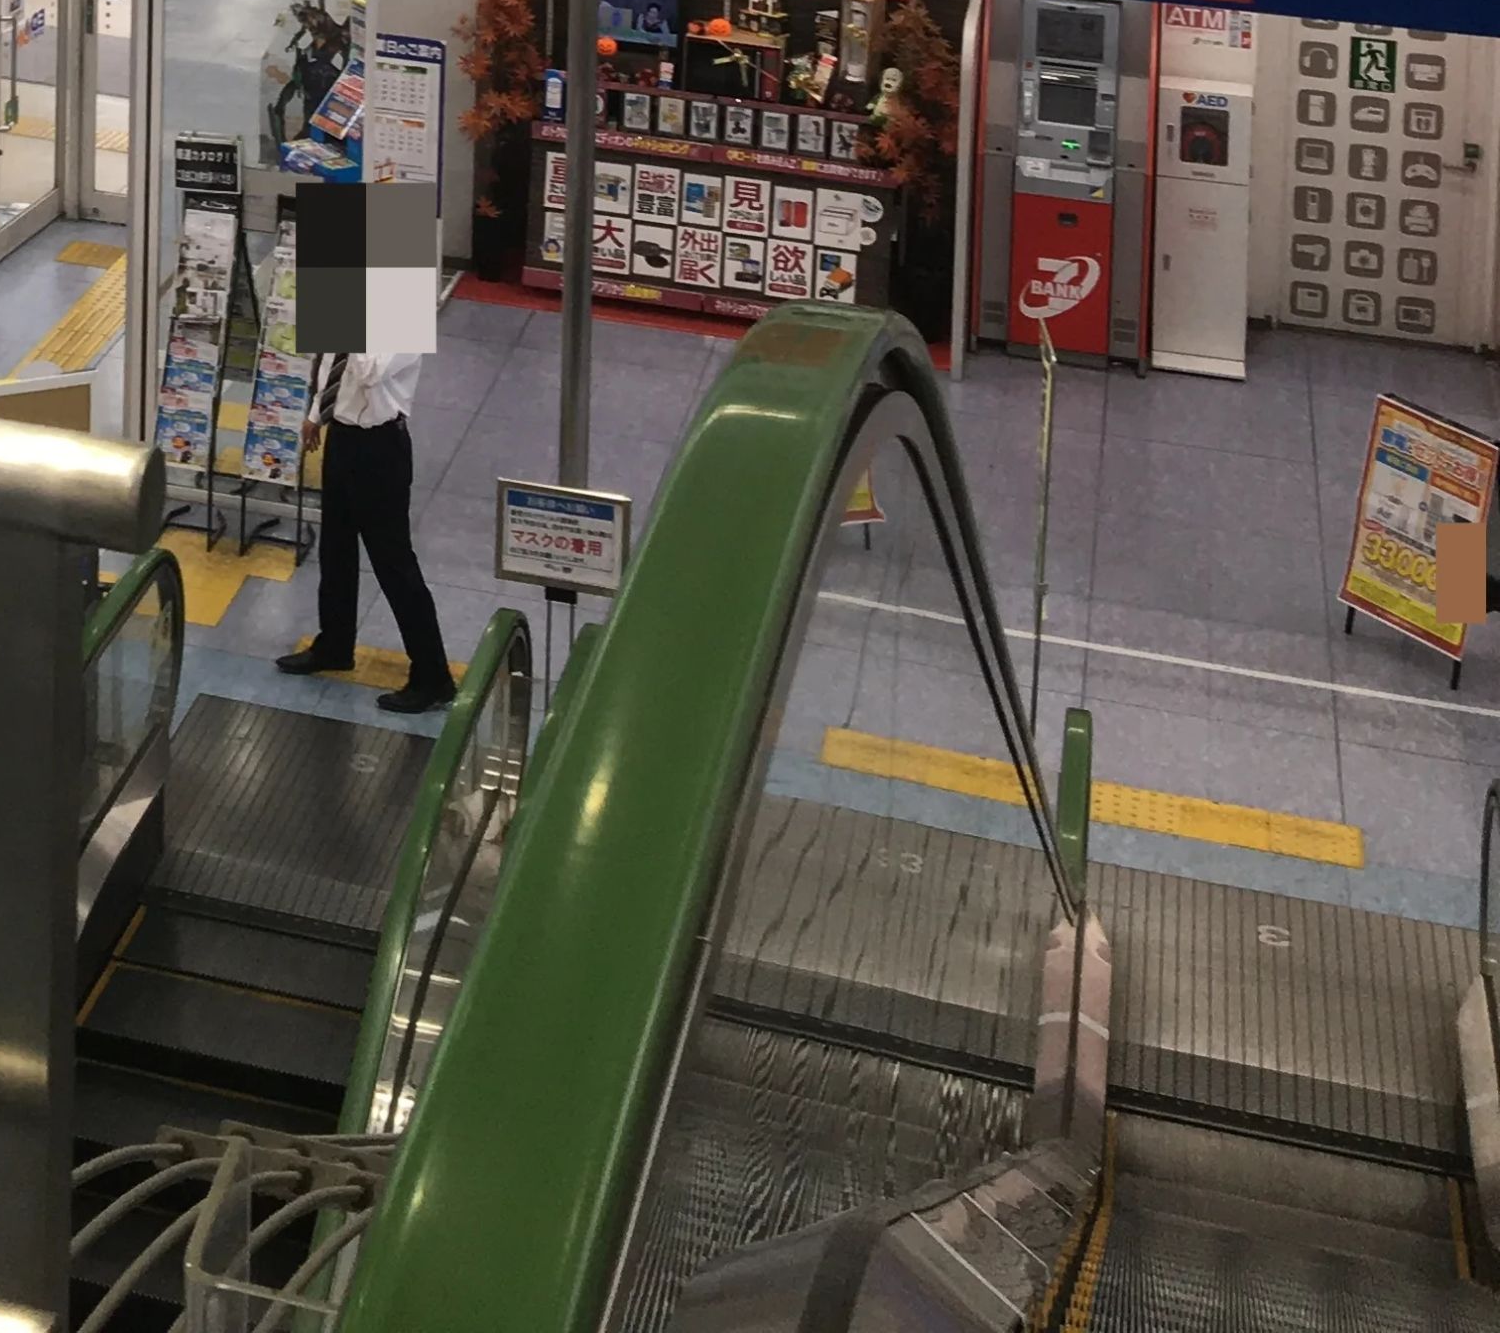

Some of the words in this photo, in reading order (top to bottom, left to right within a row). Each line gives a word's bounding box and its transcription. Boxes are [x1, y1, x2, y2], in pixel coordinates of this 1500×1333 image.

[1166, 6, 1225, 30] ATM
[1196, 93, 1229, 108] AED
[636, 193, 676, 218] 豊富
[729, 180, 764, 212] 見
[593, 219, 625, 248] 大
[680, 229, 719, 254] 外出
[680, 259, 716, 284] 届く
[772, 244, 807, 274] 欲
[1030, 278, 1084, 301] BANK
[510, 529, 603, 557] マスクの着用
